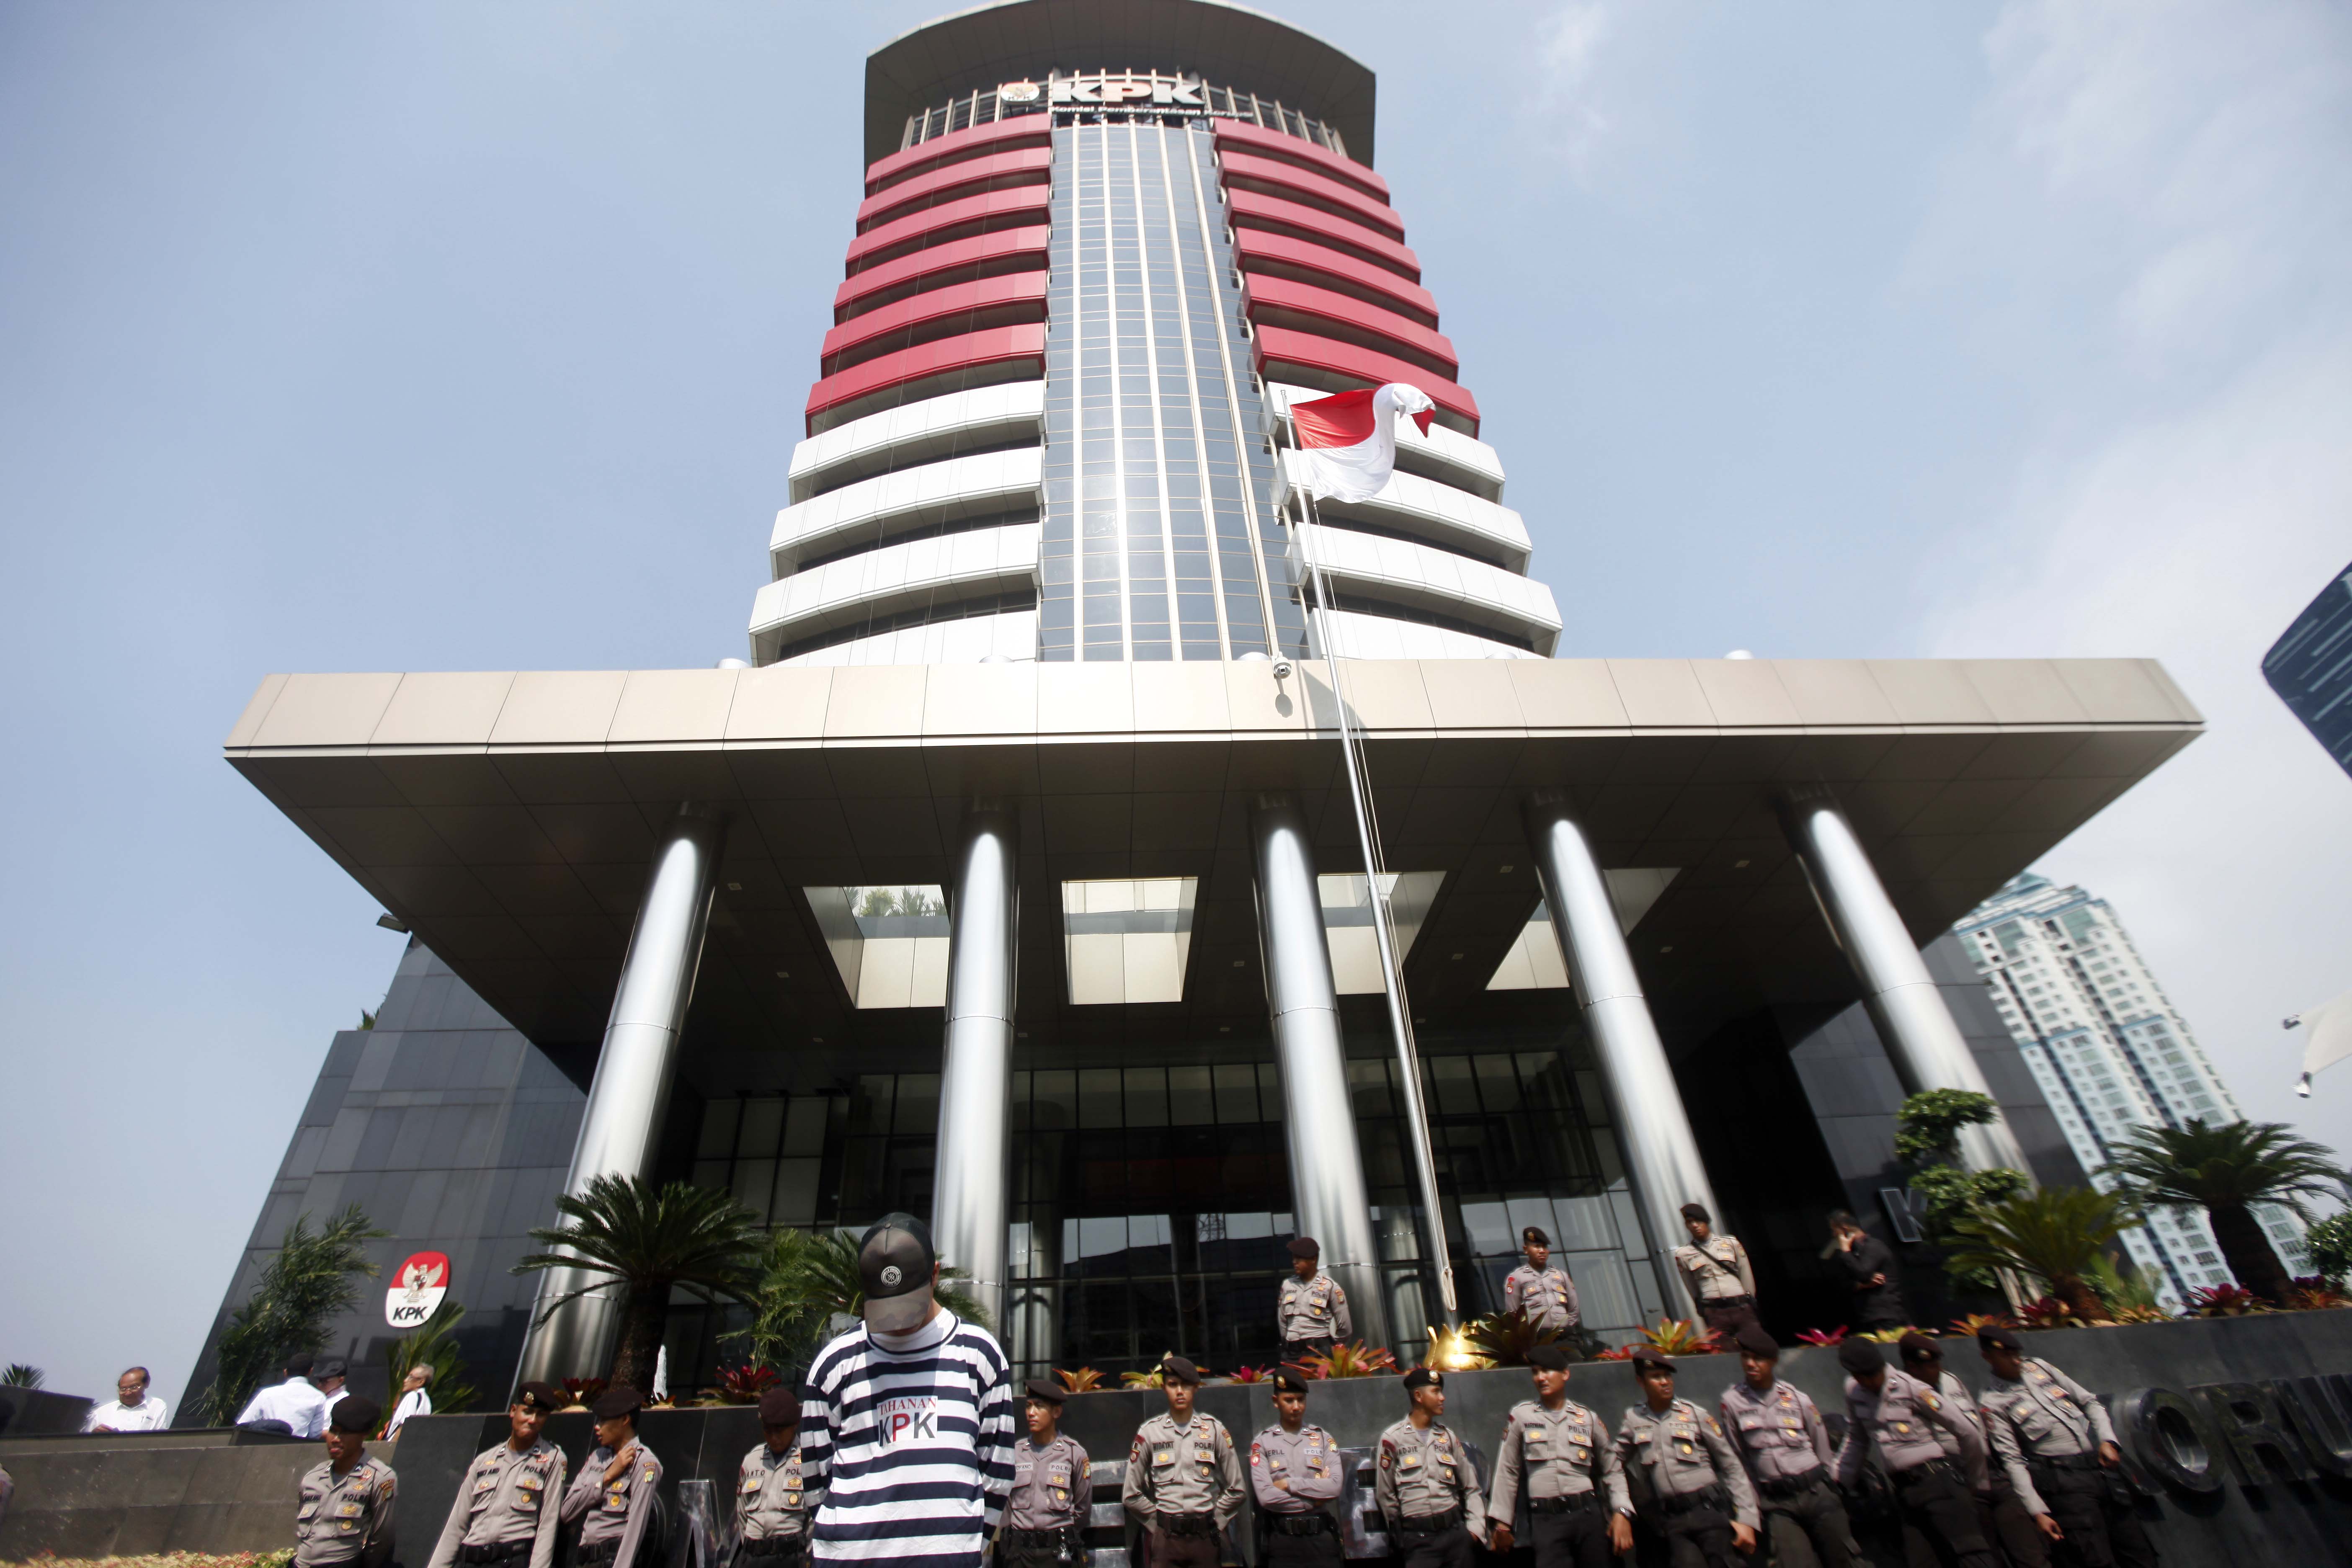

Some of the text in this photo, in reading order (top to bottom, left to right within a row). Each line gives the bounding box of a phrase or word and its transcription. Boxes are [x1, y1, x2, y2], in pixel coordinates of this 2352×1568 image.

[1052, 82, 1205, 104] KPK
[392, 1306, 427, 1320] KPK
[878, 1398, 937, 1415] TAHANAN
[879, 1412, 936, 1447] KPK
[1568, 1425, 1590, 1436] POLRI
